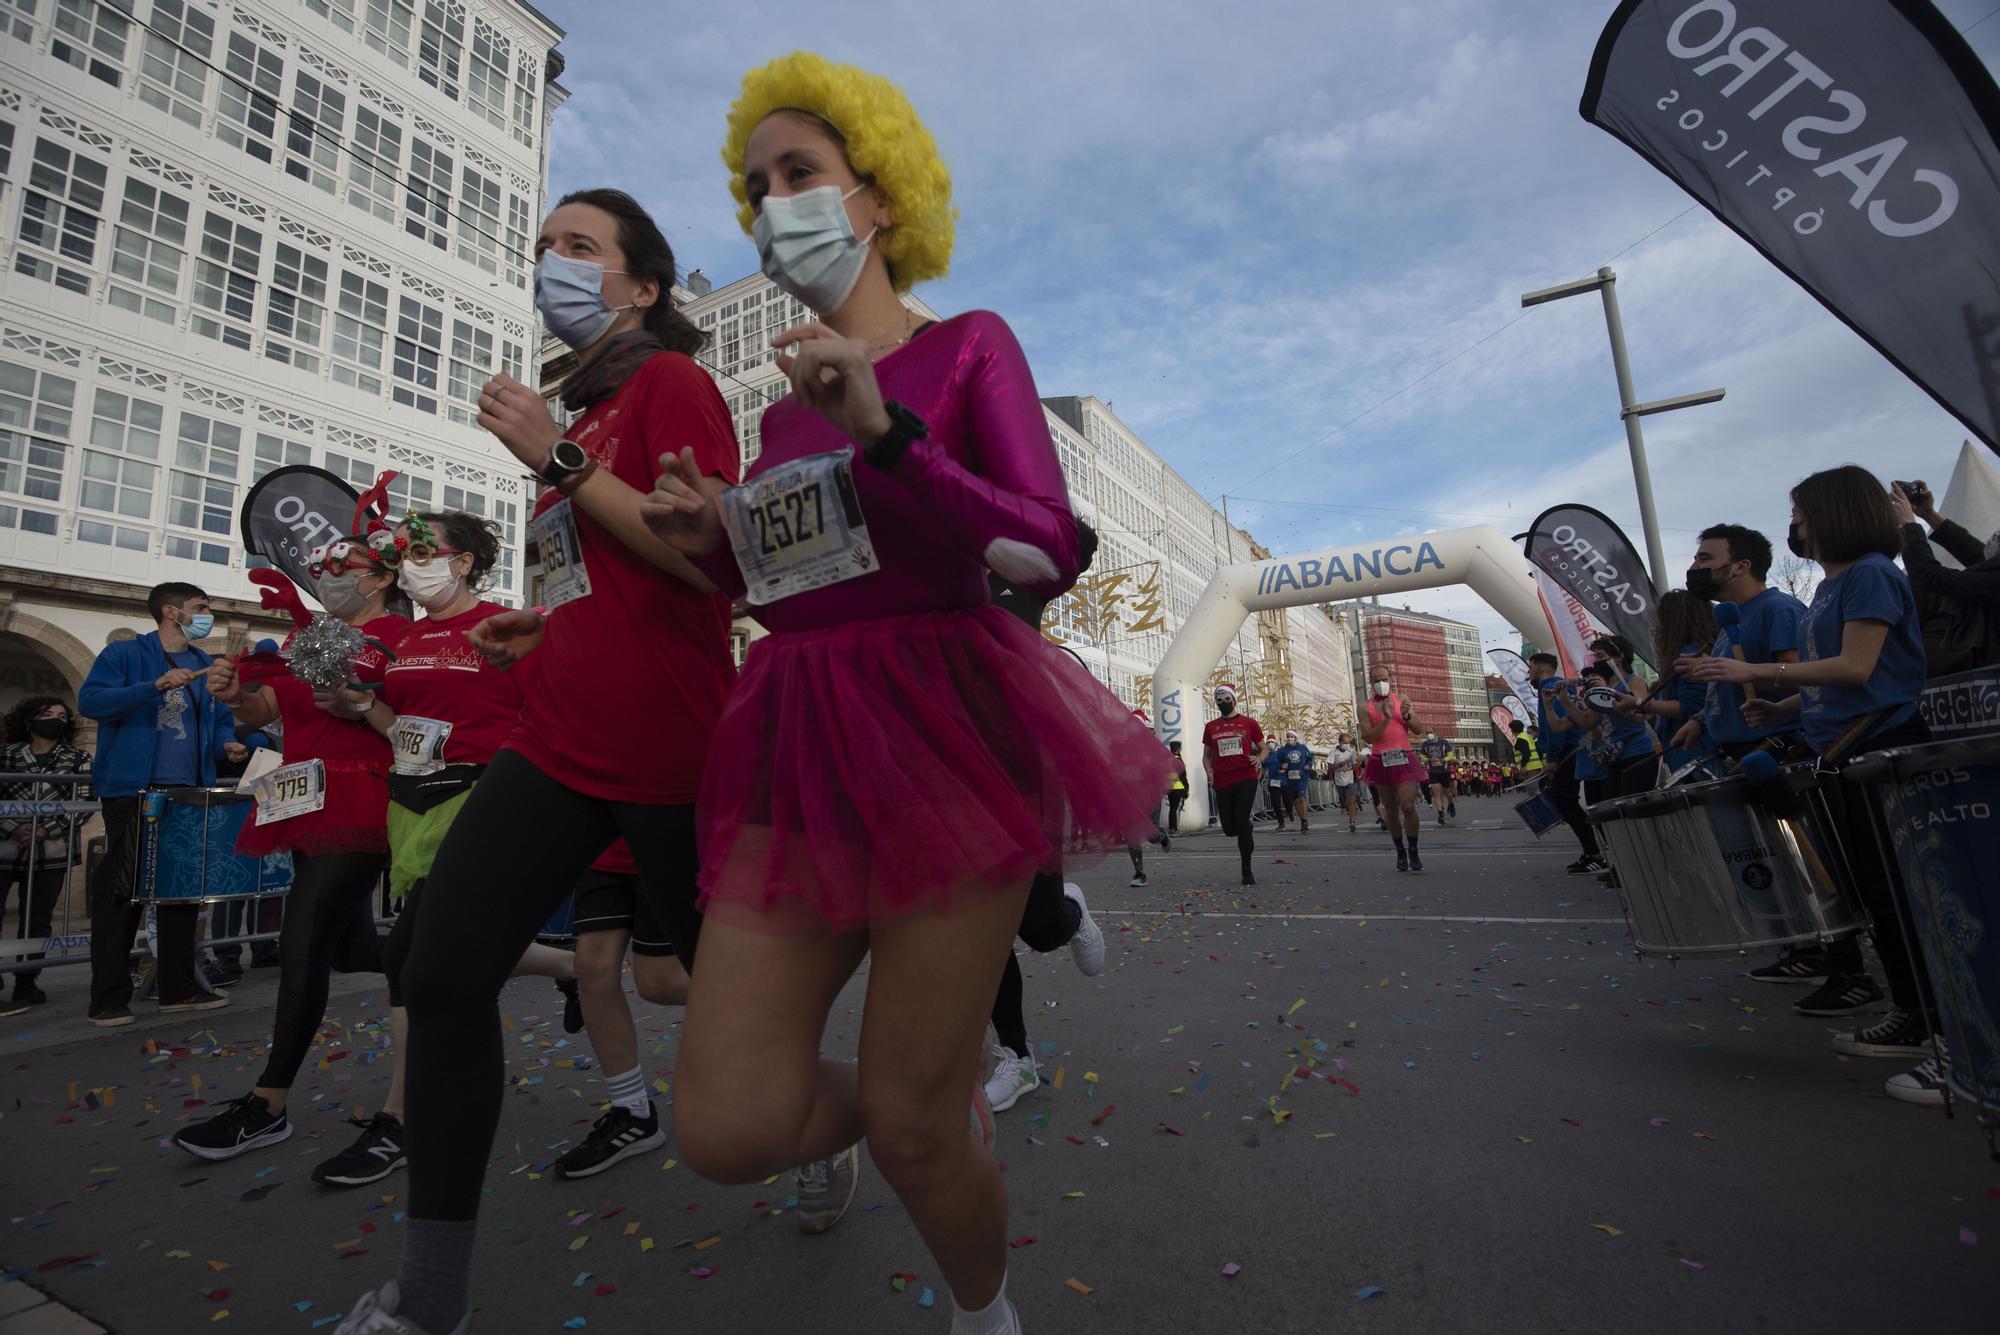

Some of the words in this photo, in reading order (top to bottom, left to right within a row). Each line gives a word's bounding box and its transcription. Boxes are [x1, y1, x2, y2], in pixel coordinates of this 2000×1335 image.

[749, 482, 824, 555] 2527
[1161, 689, 1182, 746] NCA
[399, 730, 425, 755] 778
[277, 776, 308, 802] 779
[1928, 802, 1991, 827] ALTO
